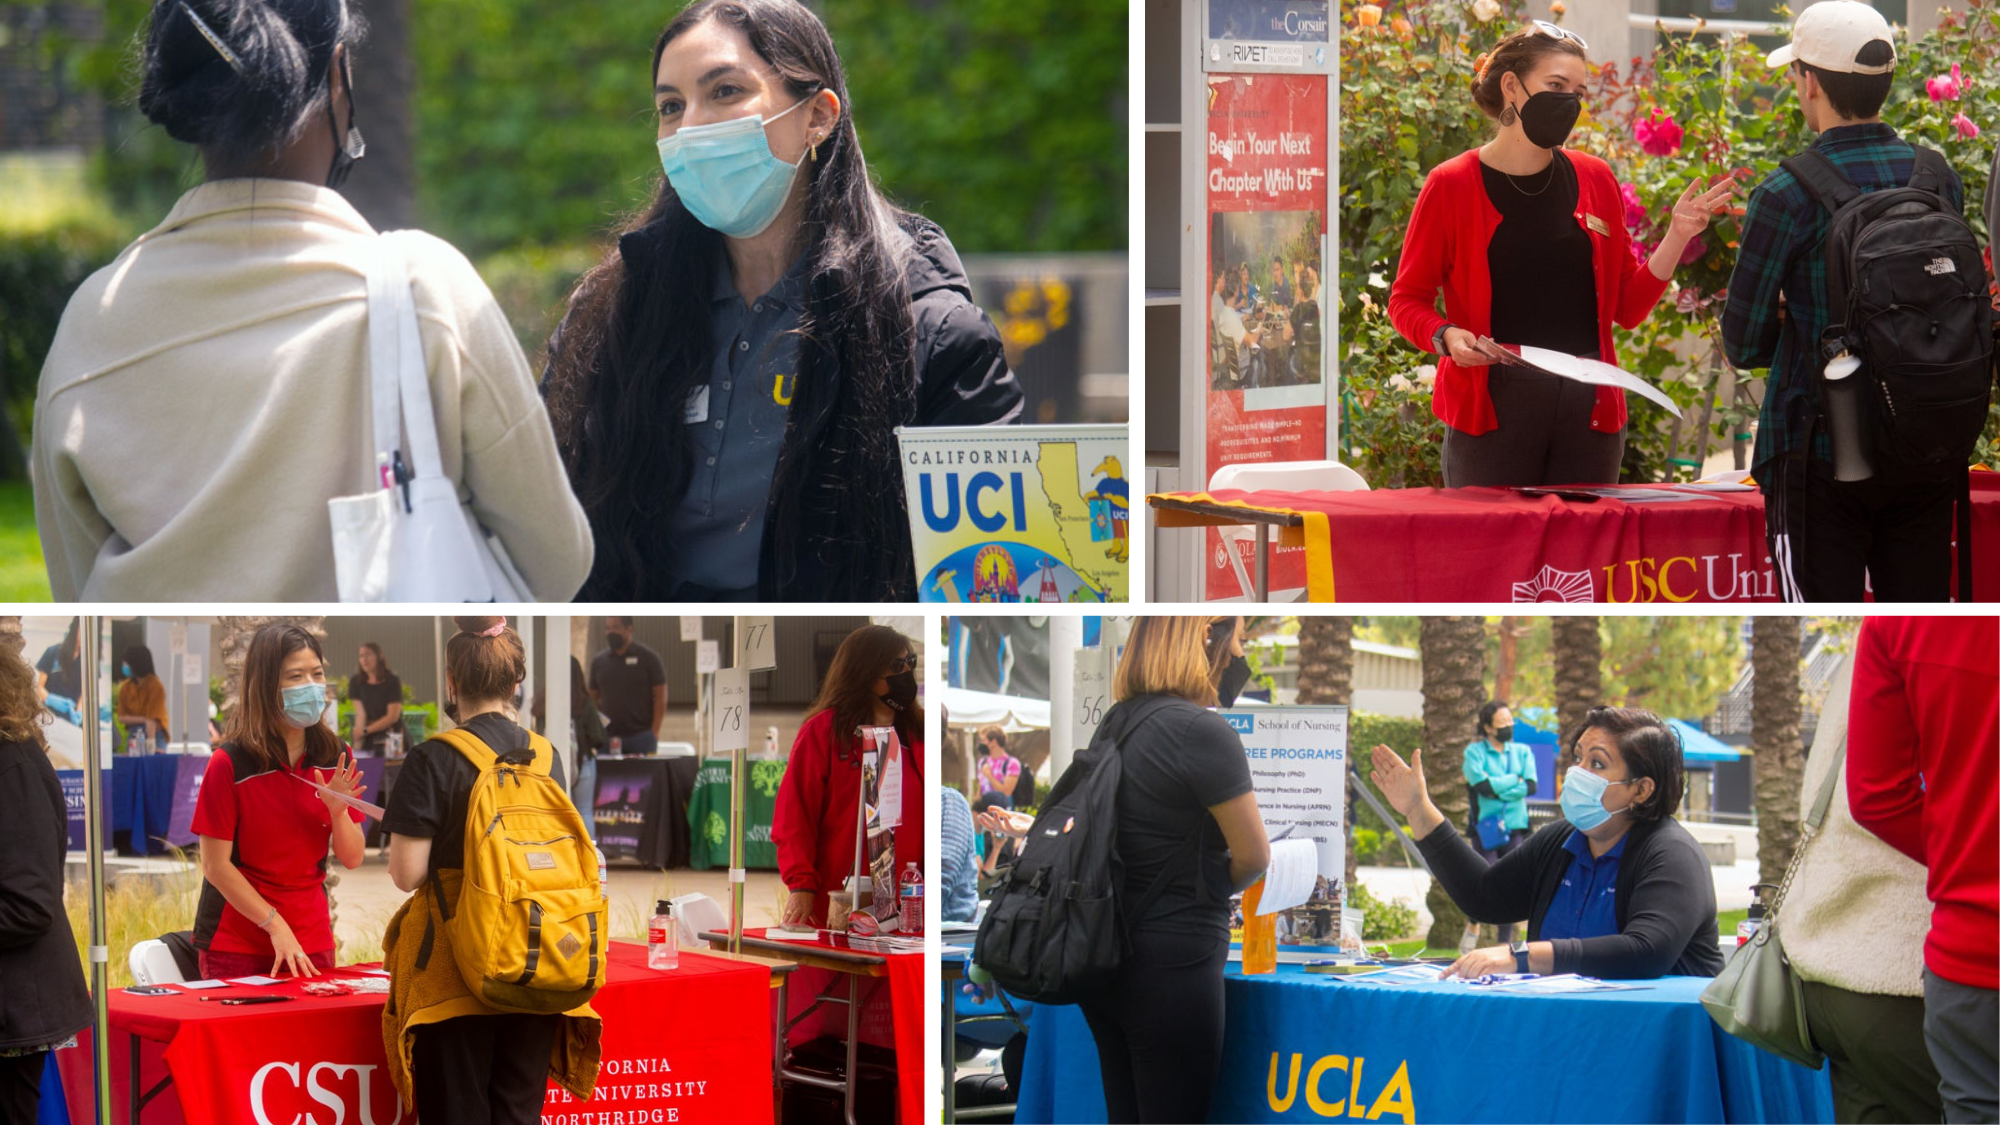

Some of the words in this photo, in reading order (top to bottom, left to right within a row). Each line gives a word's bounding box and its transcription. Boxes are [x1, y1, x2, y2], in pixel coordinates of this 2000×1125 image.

[1271, 17, 1284, 31] the
[1284, 10, 1327, 35] Corsair
[1233, 45, 1268, 62] RIVET
[1247, 132, 1277, 155] Your
[1280, 132, 1311, 155] Next
[1209, 167, 1262, 198] Chapter
[1264, 167, 1295, 191] With
[1296, 168, 1313, 191] Us
[1261, 436, 1271, 444] AND
[909, 450, 1033, 465] CALIFORNIA
[1220, 453, 1232, 462] UNIT
[919, 471, 1027, 533] UCI
[1112, 510, 1129, 520] UCI
[1602, 556, 1699, 603] USC
[1702, 553, 1777, 601] Uni
[745, 624, 768, 651] 77
[720, 705, 743, 732] 78
[1080, 694, 1105, 725] 56
[1226, 718, 1249, 729] CLA
[1258, 719, 1289, 730] School
[1291, 719, 1301, 729] of
[1303, 719, 1341, 733] Nursing
[1271, 748, 1343, 760] PROGRAMS
[1252, 769, 1286, 778] Philosophy
[1287, 770, 1305, 778] (PhD)
[1303, 787, 1322, 795] (DNP)
[1283, 803, 1306, 811] Nursing
[1288, 819, 1312, 827] rsing
[250, 1061, 403, 1125] CSU
[594, 1081, 708, 1102] NIVERSITY
[1266, 1051, 1416, 1125] UCLA
[541, 1107, 679, 1125] NORTHRIDGE
